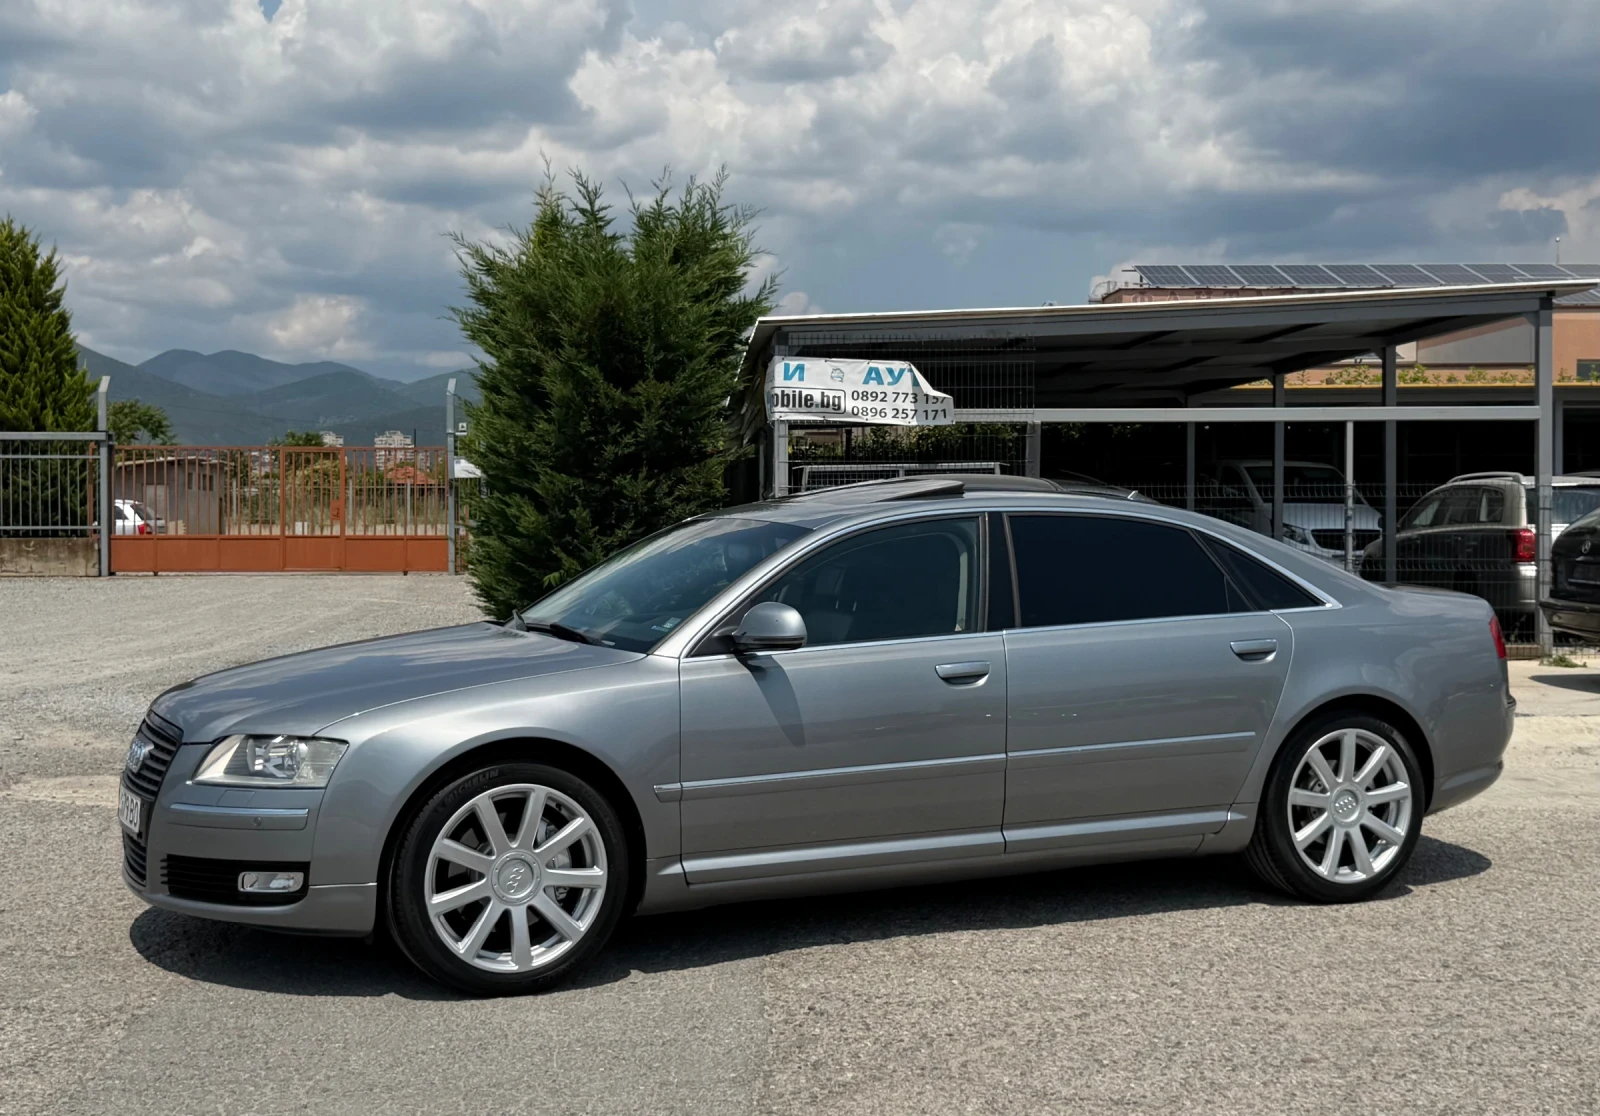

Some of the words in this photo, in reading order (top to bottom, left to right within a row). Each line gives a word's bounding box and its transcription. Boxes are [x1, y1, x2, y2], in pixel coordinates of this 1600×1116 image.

[768, 390, 841, 411] obile.bg
[851, 390, 888, 403] 0892
[892, 391, 918, 404] 773
[851, 405, 887, 418] 0896
[891, 408, 918, 420] 257
[922, 408, 947, 421] 171
